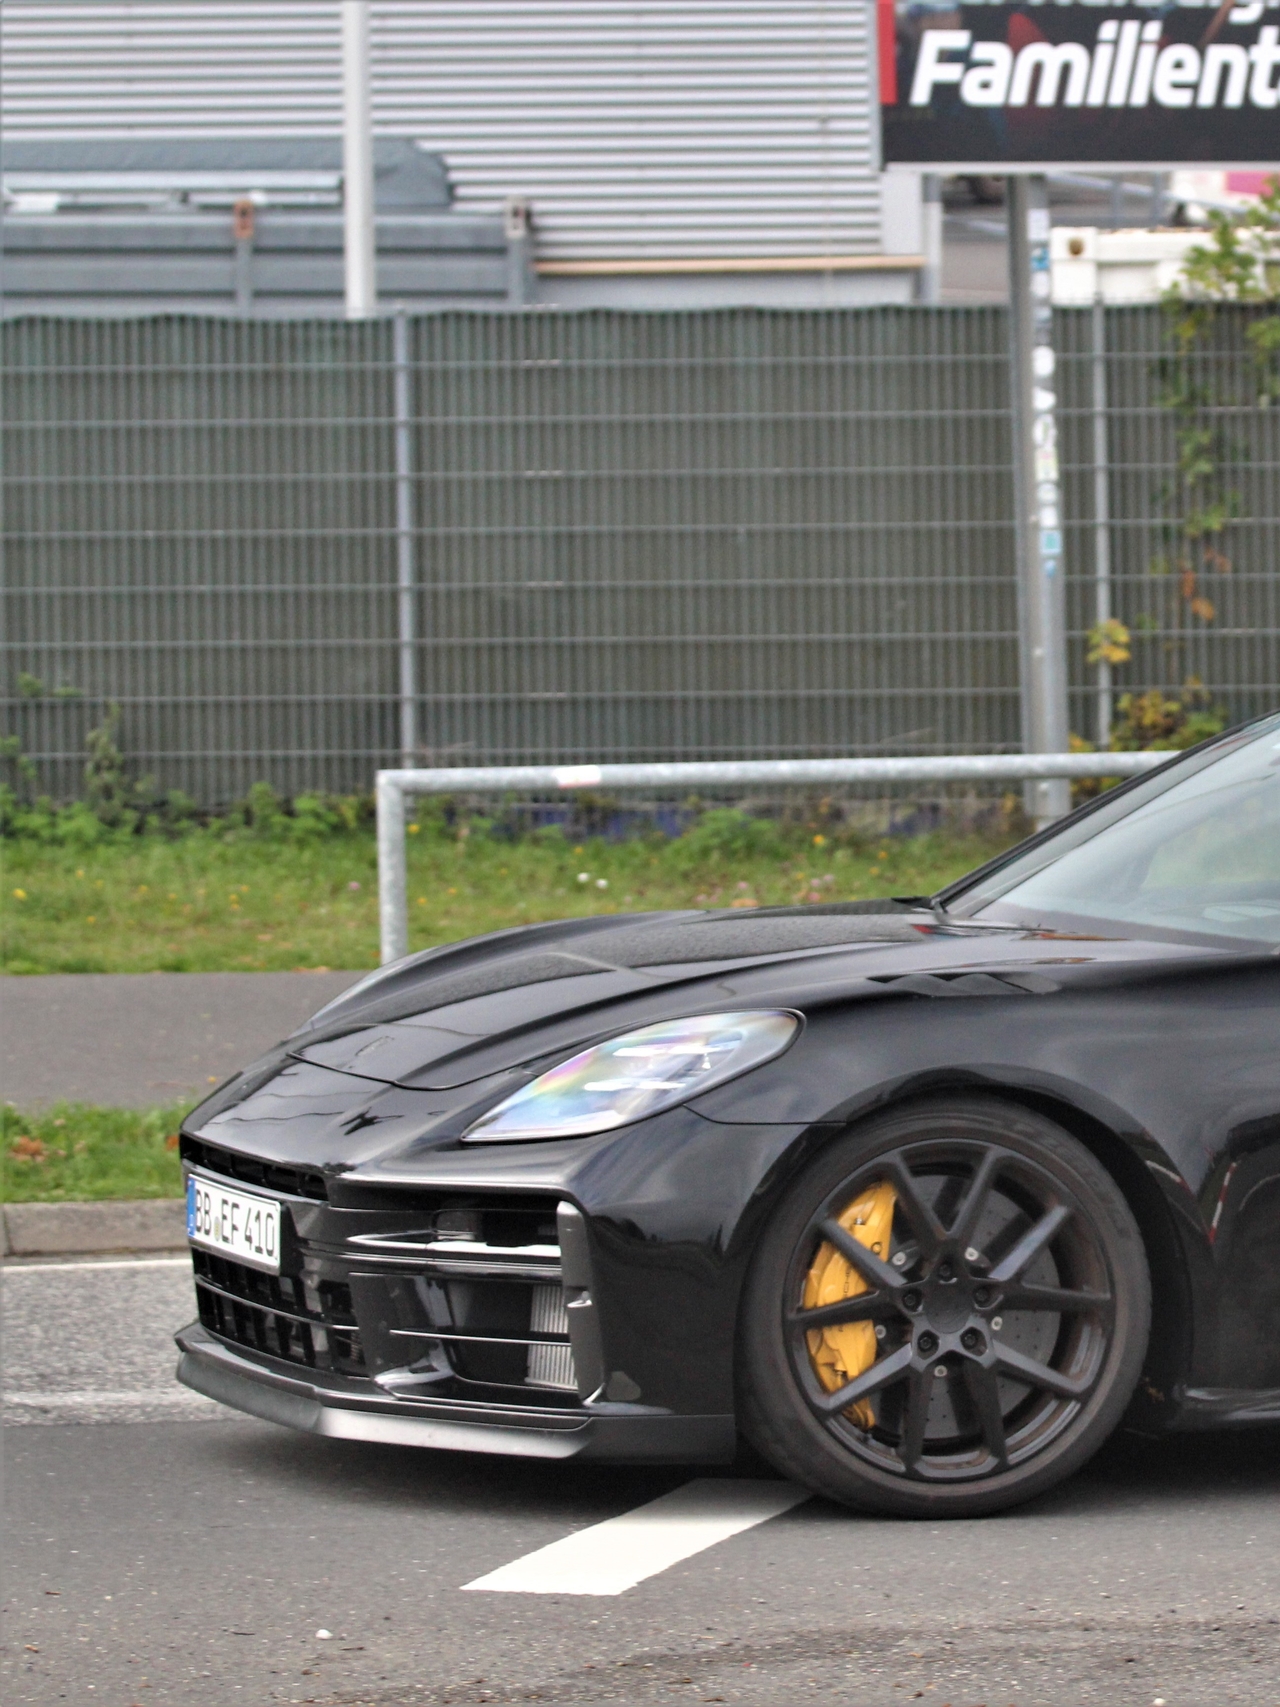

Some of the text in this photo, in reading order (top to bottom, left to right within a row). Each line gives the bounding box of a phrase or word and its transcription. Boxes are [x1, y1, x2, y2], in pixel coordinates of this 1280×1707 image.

[196, 1189, 275, 1257] BB EF 410
